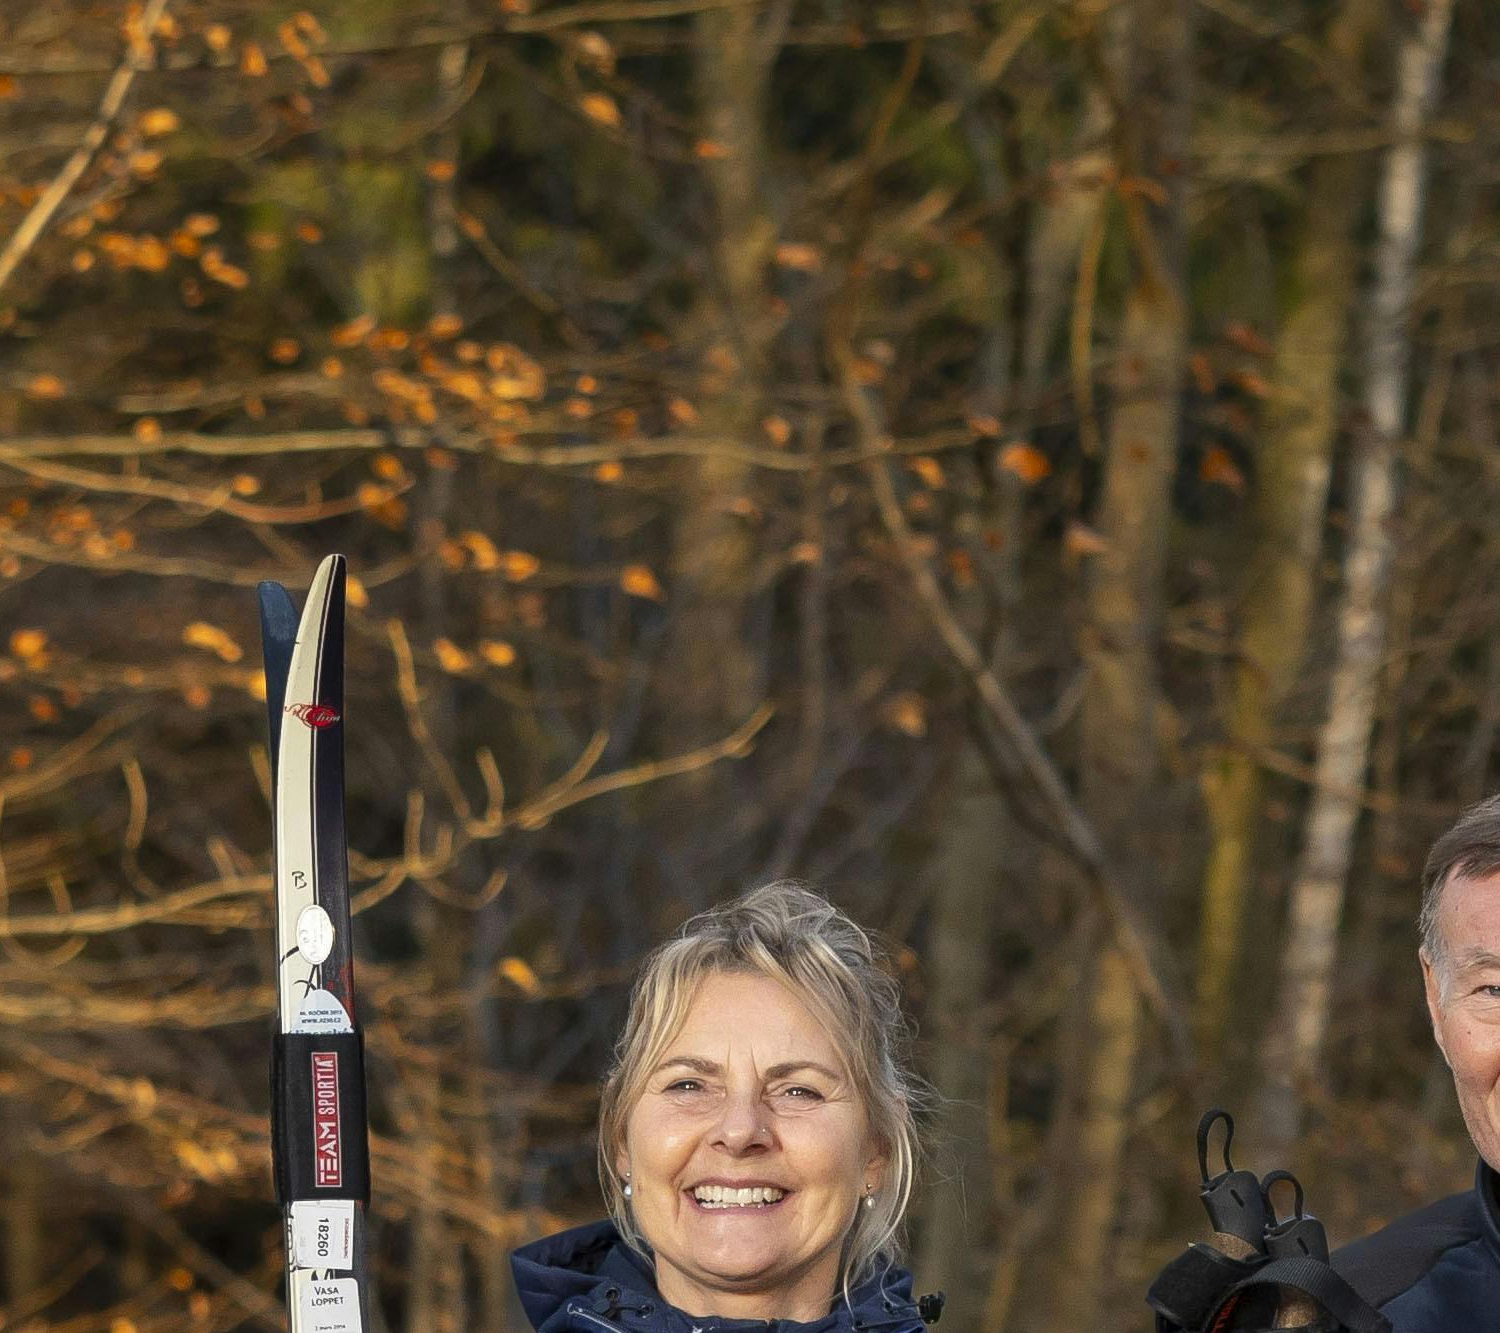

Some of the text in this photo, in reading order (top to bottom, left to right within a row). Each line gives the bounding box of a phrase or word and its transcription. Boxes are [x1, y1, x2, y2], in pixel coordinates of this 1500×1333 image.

[291, 870, 308, 890] B
[319, 1121, 338, 1184] TEAM
[317, 1217, 330, 1257] 18260
[311, 1296, 344, 1307] LOPPET
